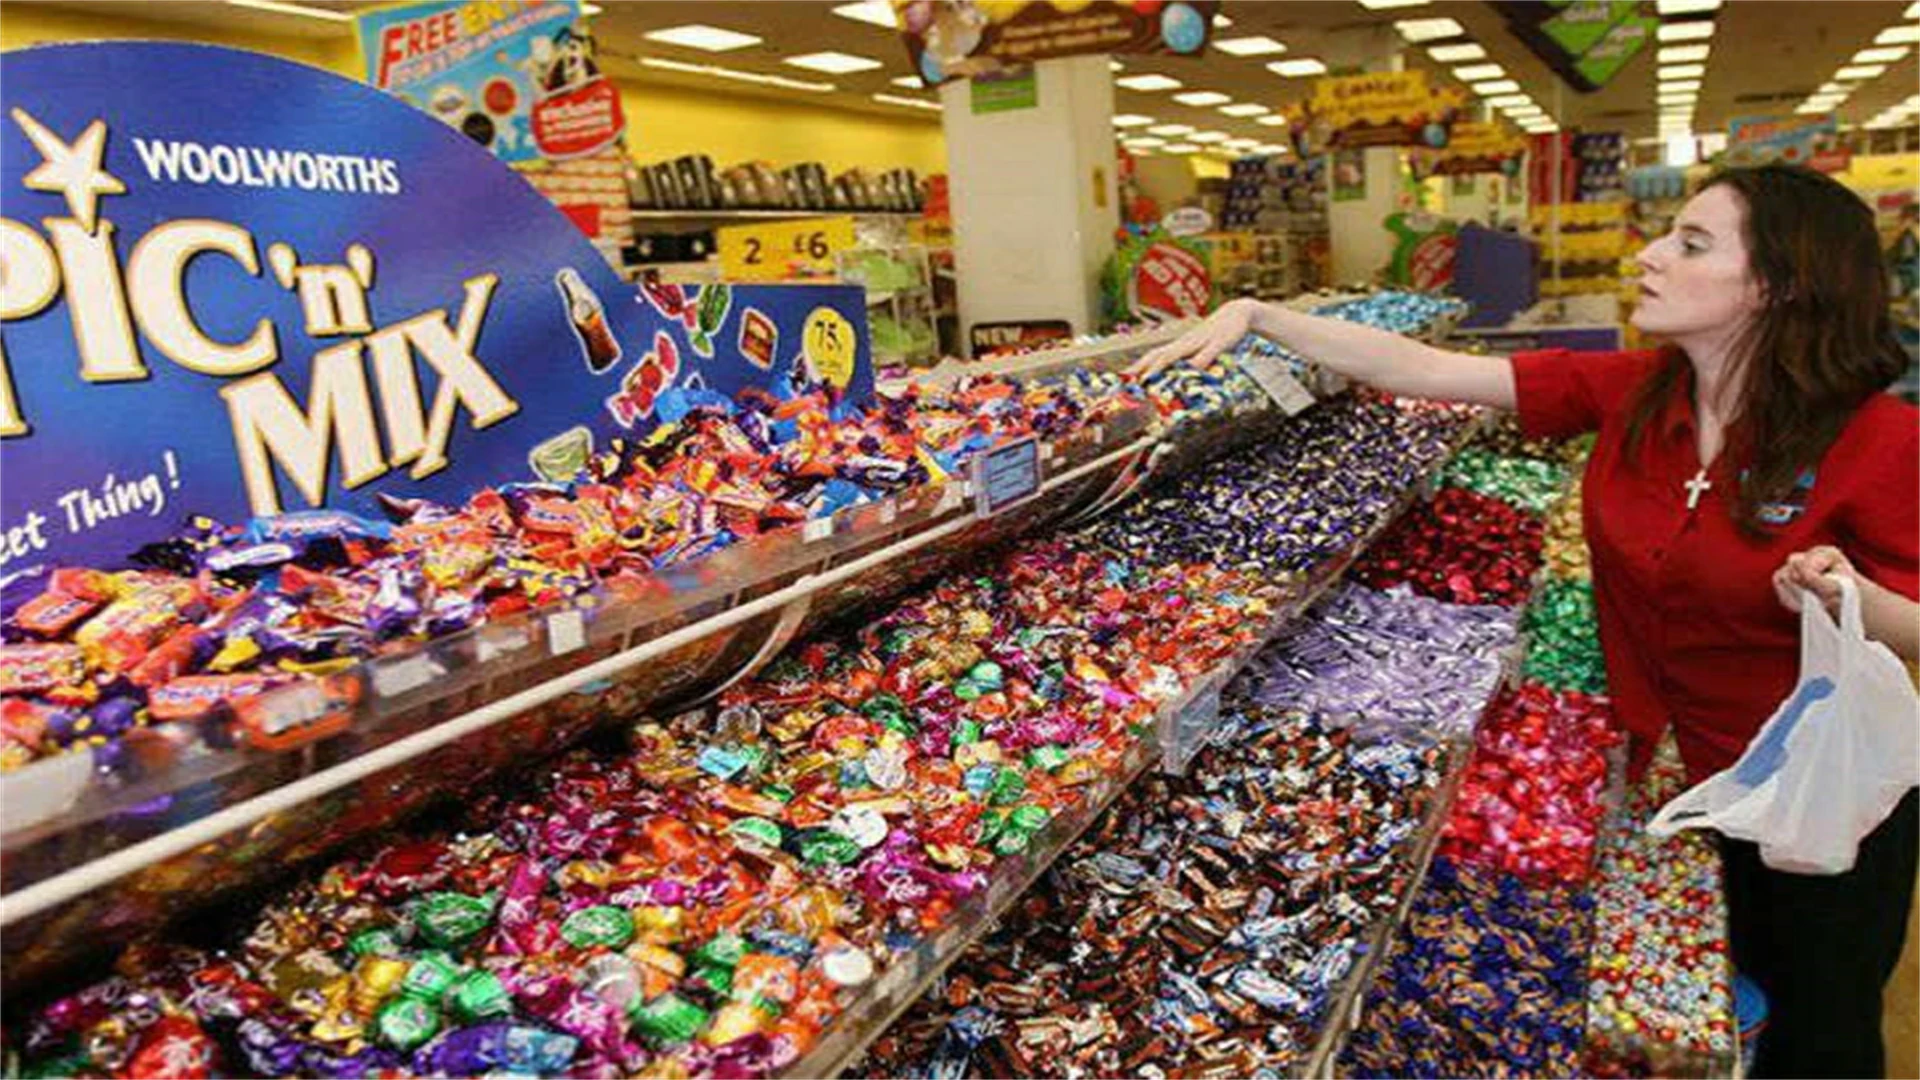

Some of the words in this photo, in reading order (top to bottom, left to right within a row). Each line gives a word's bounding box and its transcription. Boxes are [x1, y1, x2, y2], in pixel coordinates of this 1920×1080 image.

[377, 11, 457, 89] FREE
[132, 138, 400, 194] WOOLWORTHS
[743, 237, 762, 265] 2
[793, 231, 829, 260] £6
[973, 327, 1023, 346] NEW
[218, 272, 520, 517] MIX
